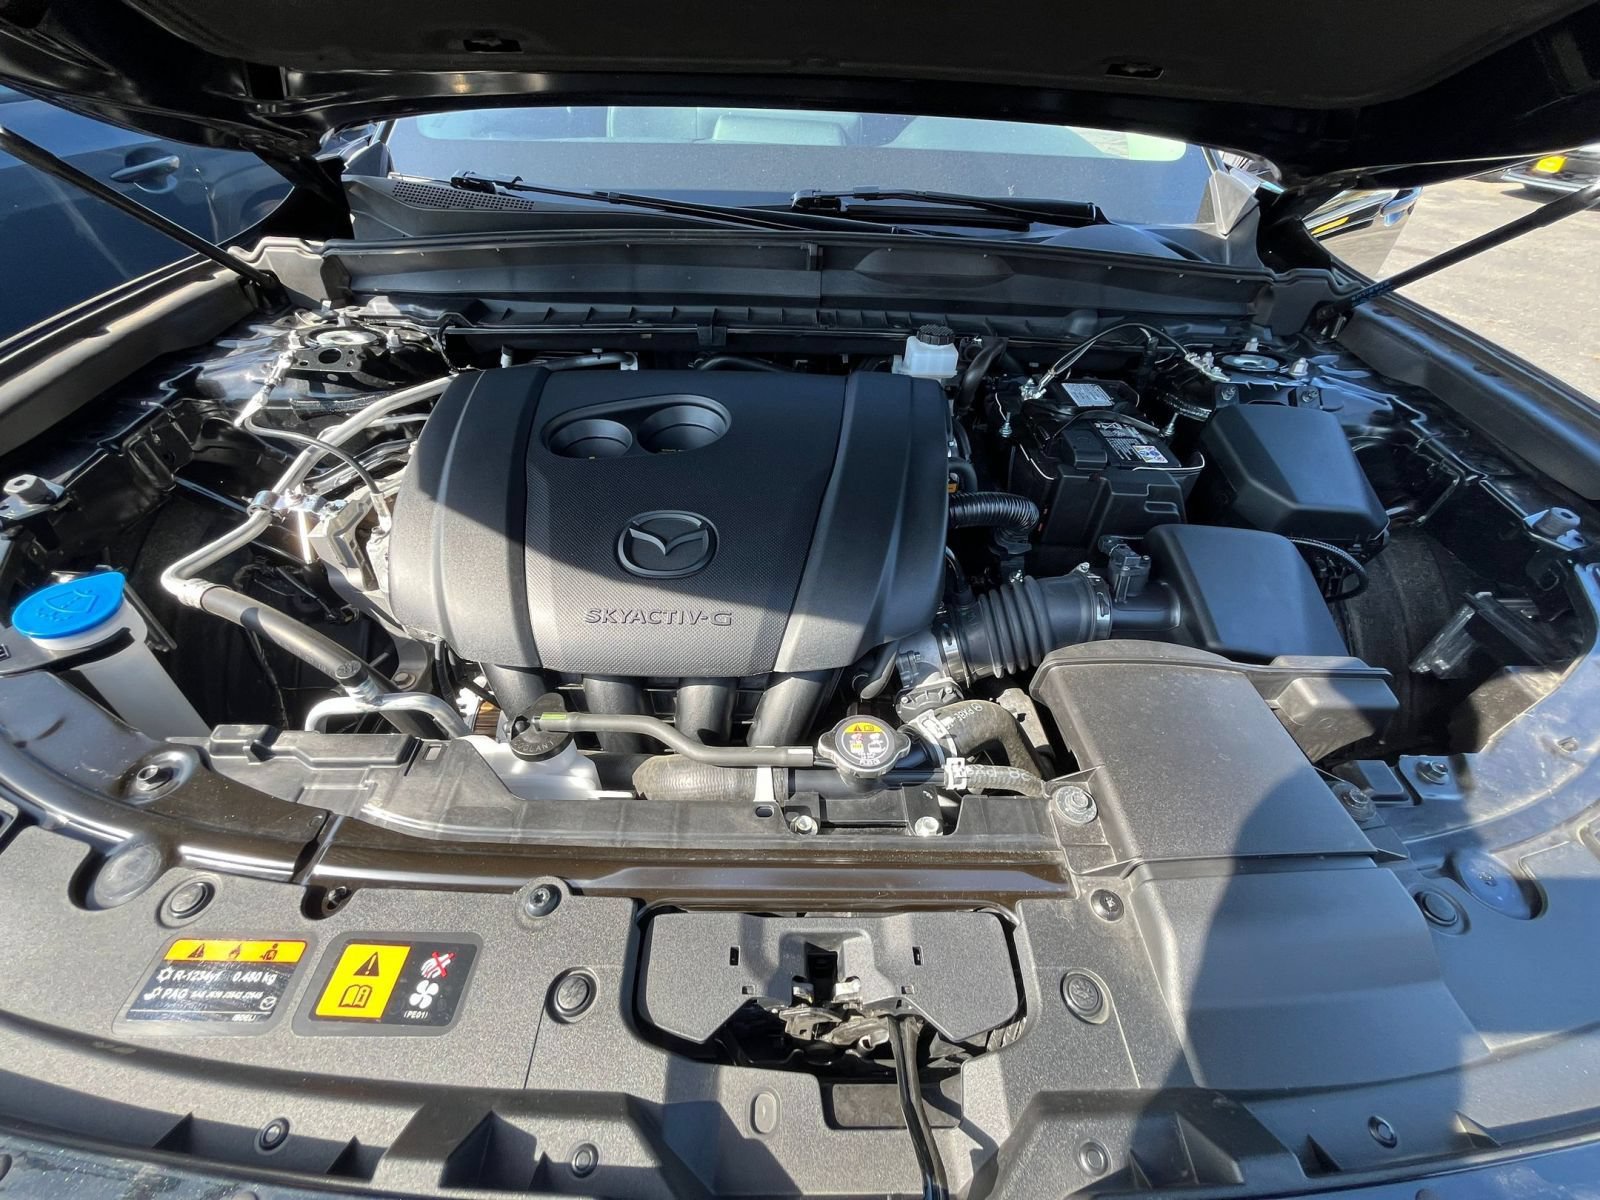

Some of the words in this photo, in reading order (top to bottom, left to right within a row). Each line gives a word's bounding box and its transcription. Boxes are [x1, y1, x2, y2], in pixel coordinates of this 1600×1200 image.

[585, 607, 733, 627] SKYACTIV-G
[172, 969, 223, 984] R-1234yf
[261, 971, 278, 986] kg
[160, 988, 190, 1000] PAG
